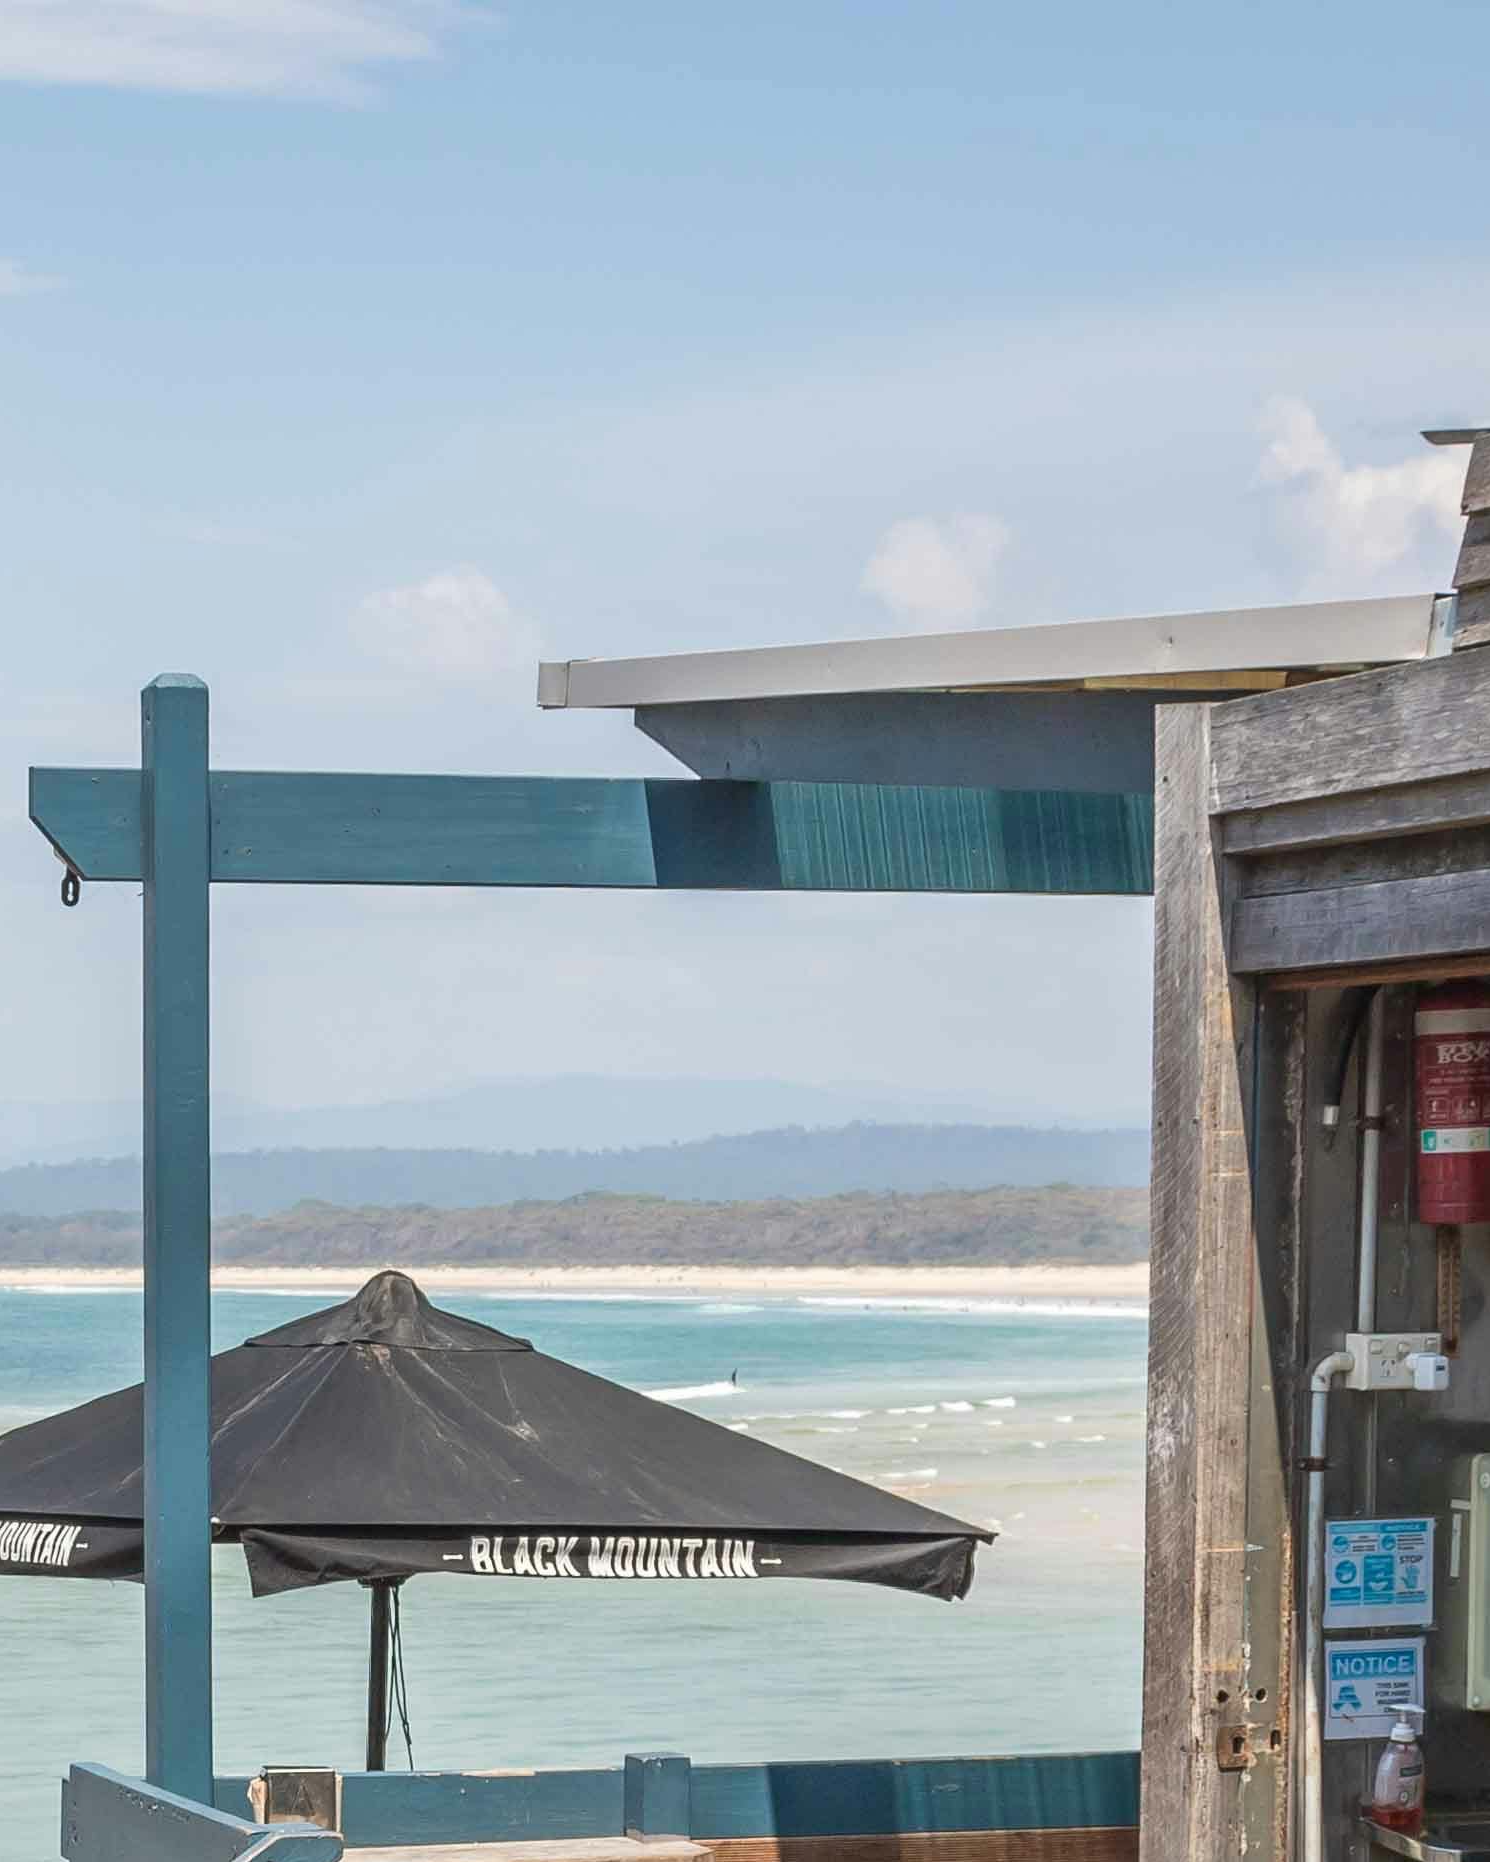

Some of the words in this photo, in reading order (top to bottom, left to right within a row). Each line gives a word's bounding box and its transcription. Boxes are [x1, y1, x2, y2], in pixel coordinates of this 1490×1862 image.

[470, 1536, 581, 1577] BLACK
[587, 1536, 759, 1578] MOUNTAIN
[1335, 1655, 1411, 1676] NOTICE
